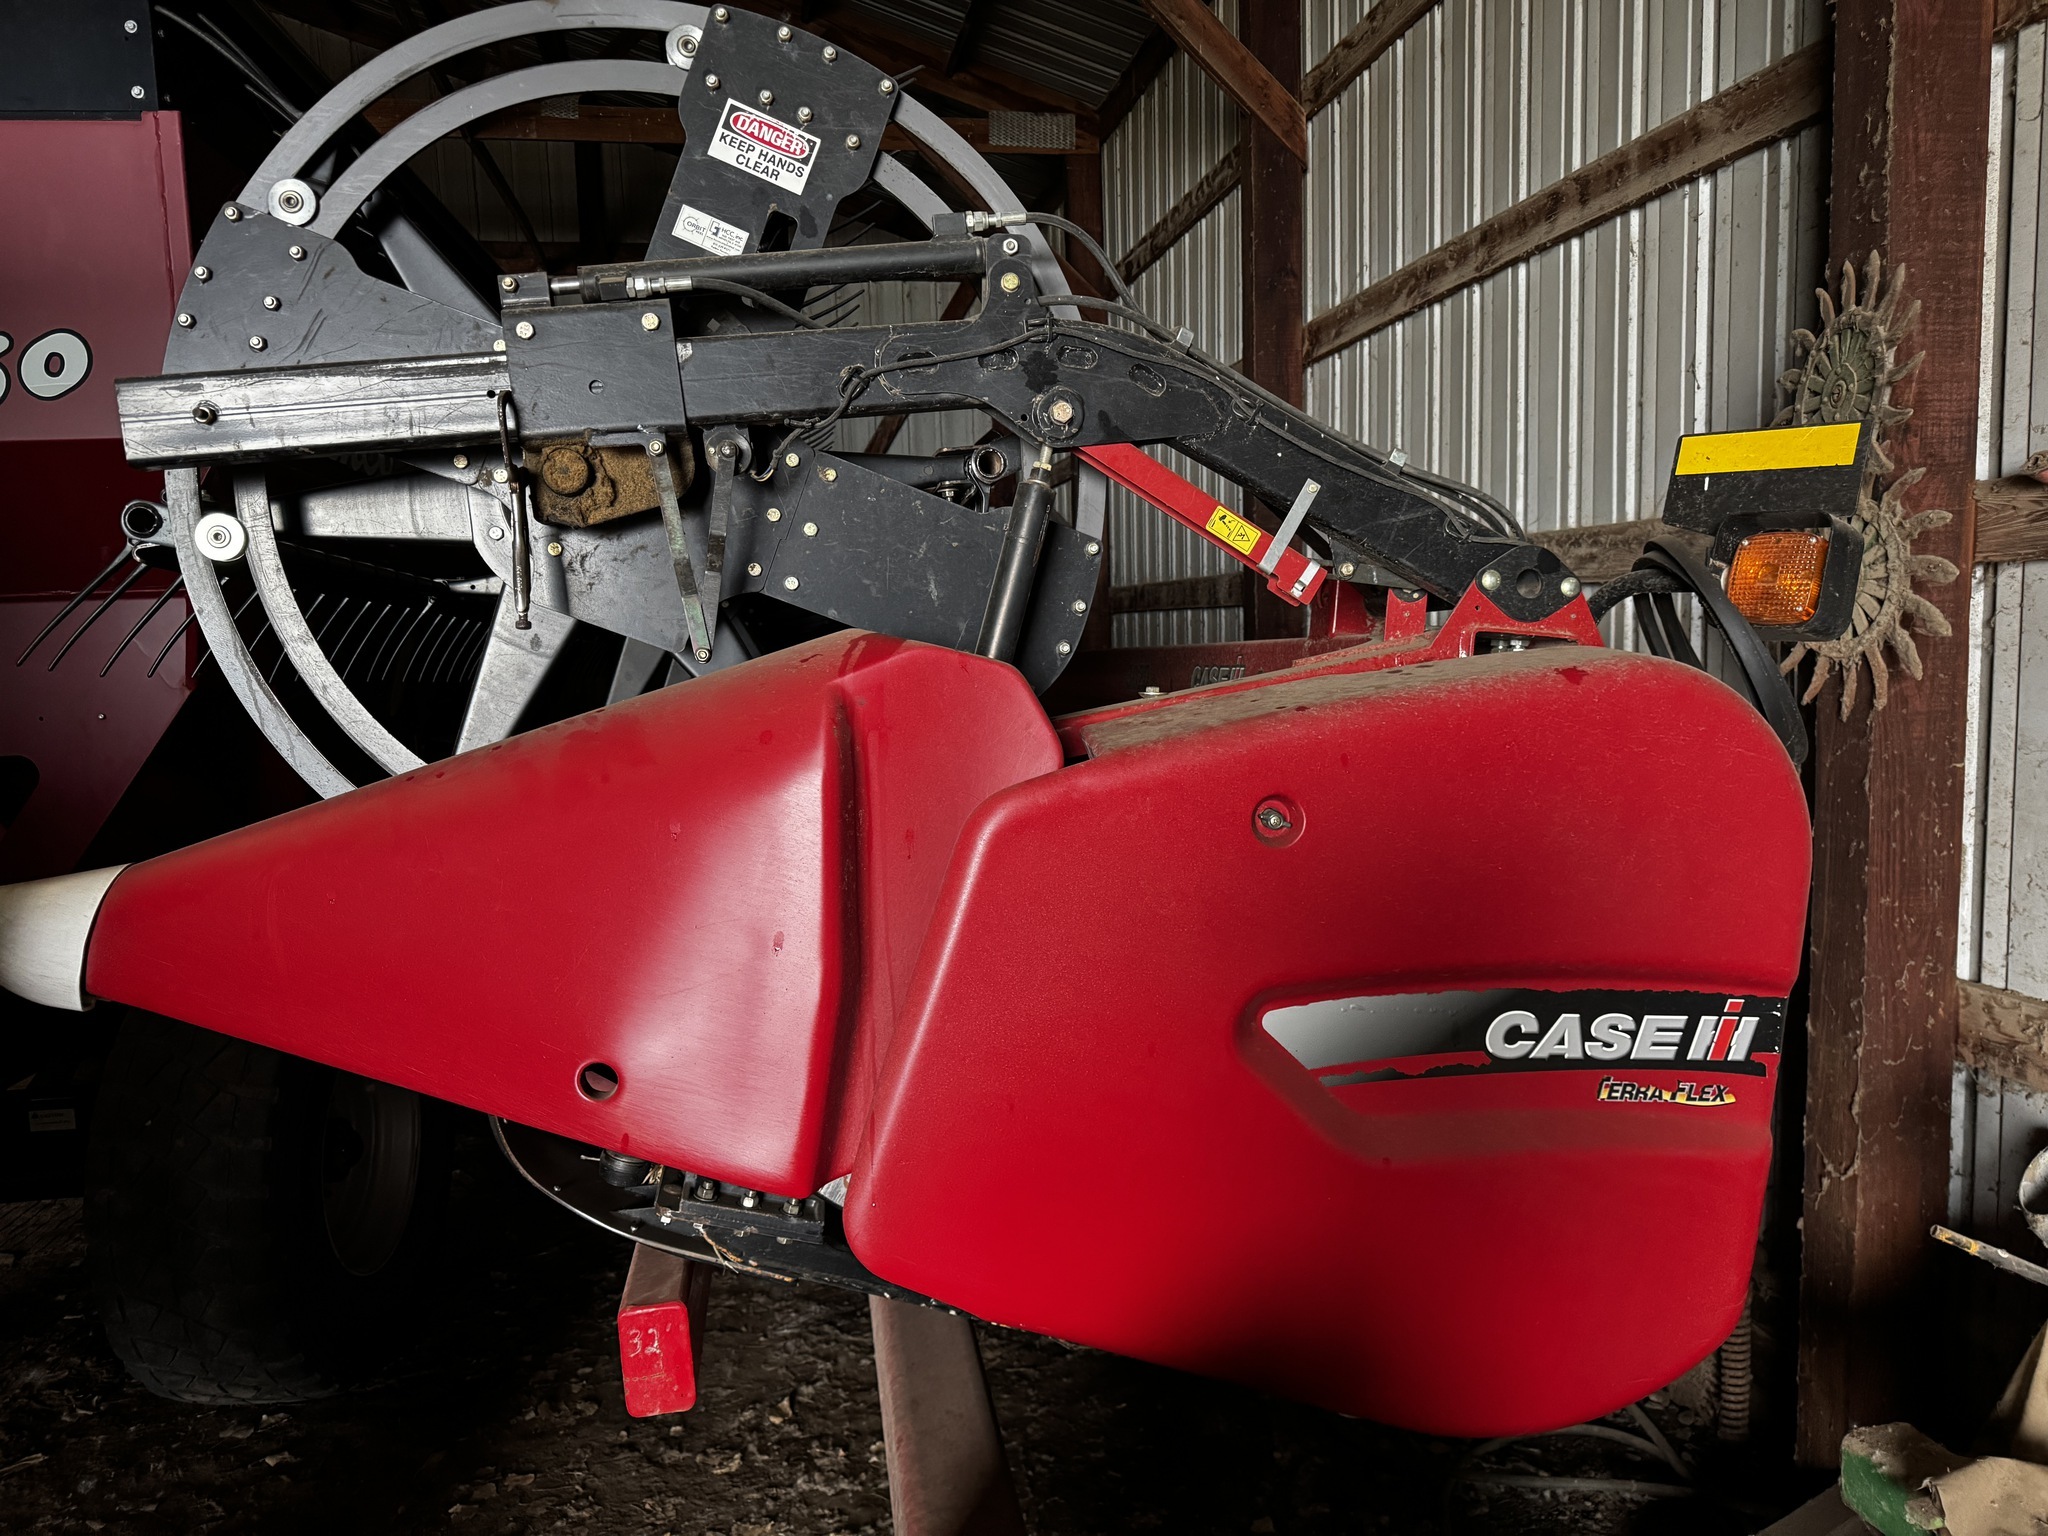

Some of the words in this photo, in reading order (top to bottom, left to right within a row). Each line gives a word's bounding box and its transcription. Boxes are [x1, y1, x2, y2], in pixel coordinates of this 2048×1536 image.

[735, 113, 804, 157] DANGER
[719, 131, 755, 154] KEEP
[758, 148, 805, 178] HANDS
[735, 153, 780, 181] CLEAR
[686, 220, 706, 233] ORBIT
[0, 328, 94, 406] 0
[1192, 666, 1229, 687] CASE
[1485, 1010, 1689, 1060] CASE
[1669, 1079, 1730, 1102] FLEX
